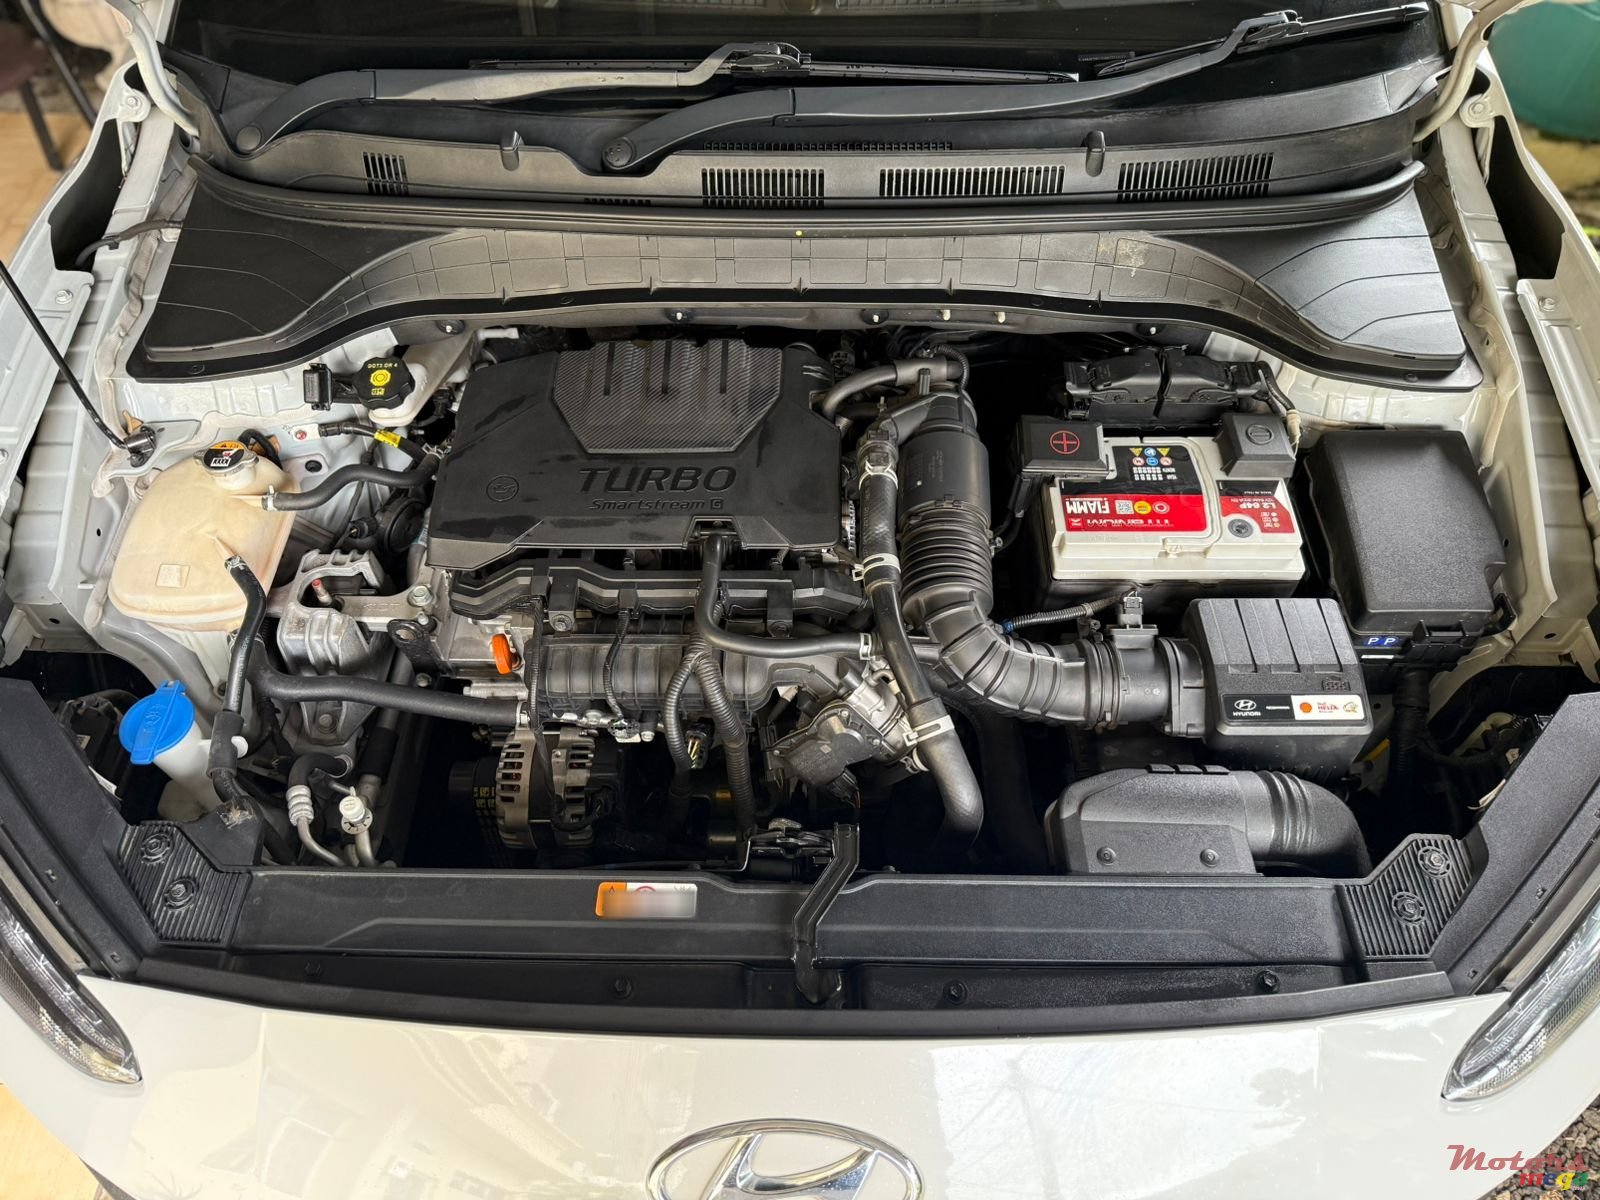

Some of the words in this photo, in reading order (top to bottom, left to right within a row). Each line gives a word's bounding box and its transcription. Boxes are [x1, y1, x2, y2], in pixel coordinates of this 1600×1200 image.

[579, 466, 737, 493] TURBO
[588, 498, 704, 511] Smartstream
[710, 499, 724, 510] G
[1065, 499, 1110, 514] FIAMM
[1367, 637, 1380, 645] P
[1383, 637, 1396, 646] P
